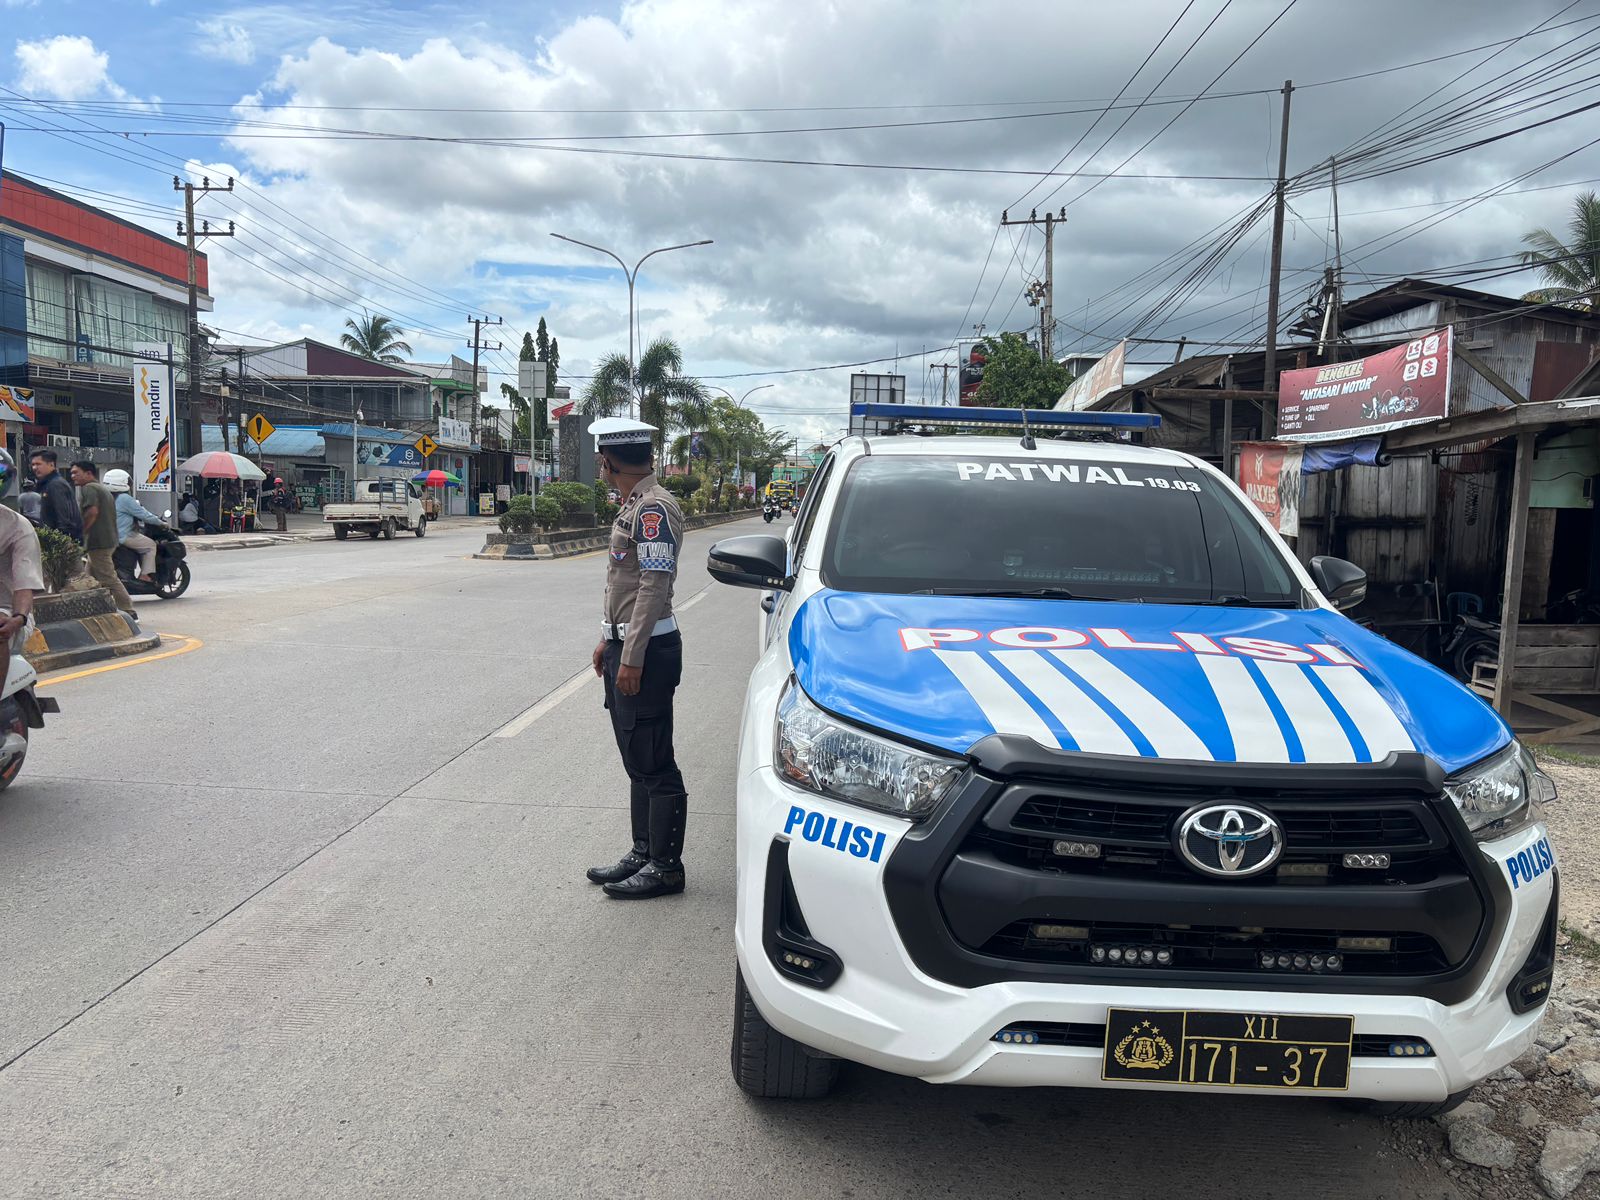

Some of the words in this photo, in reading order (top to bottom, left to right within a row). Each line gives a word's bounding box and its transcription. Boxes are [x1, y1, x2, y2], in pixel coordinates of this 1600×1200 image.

[138, 348, 160, 359] atm
[1317, 362, 1363, 382] BENGKEL
[1341, 376, 1378, 395] MOTOR"
[148, 380, 160, 431] mandiri
[1285, 405, 1299, 413] SERVICE
[956, 462, 1144, 487] PATWAL
[1144, 477, 1201, 492] 19.03
[1246, 482, 1277, 505] MAXXIS
[899, 627, 1368, 668] POLISI
[783, 805, 887, 864] POLISI
[1506, 836, 1554, 890] POLISI
[1243, 1016, 1280, 1040] XII
[1187, 1043, 1238, 1084] 171
[1282, 1047, 1328, 1087] 37
